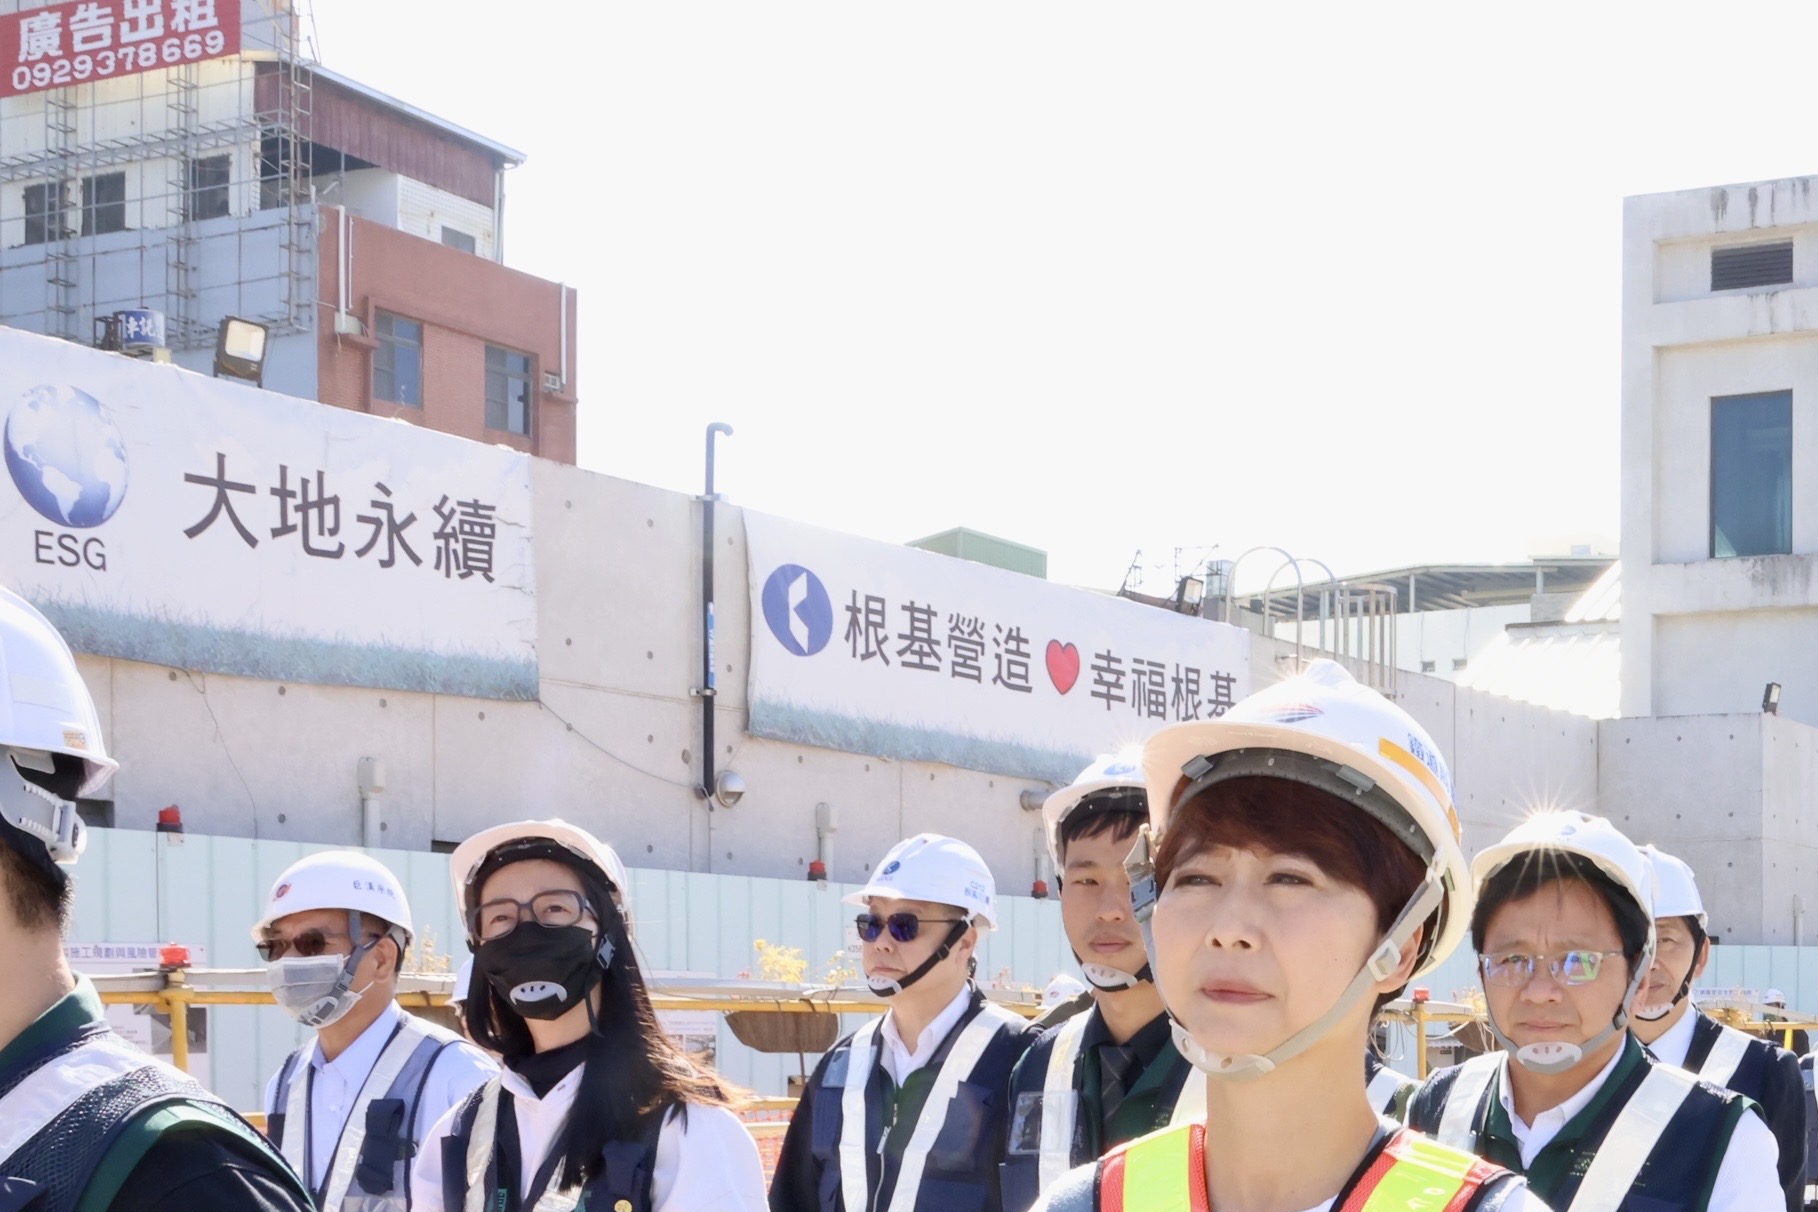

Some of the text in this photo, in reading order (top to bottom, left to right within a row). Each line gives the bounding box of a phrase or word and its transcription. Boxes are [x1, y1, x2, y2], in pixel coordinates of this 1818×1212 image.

[12, 30, 225, 90] 0929378669
[18, 0, 219, 62] 廣告出租
[183, 451, 497, 584] 大地永續
[34, 530, 107, 572] ESG
[844, 589, 1237, 721] 根基營造 幸福根基
